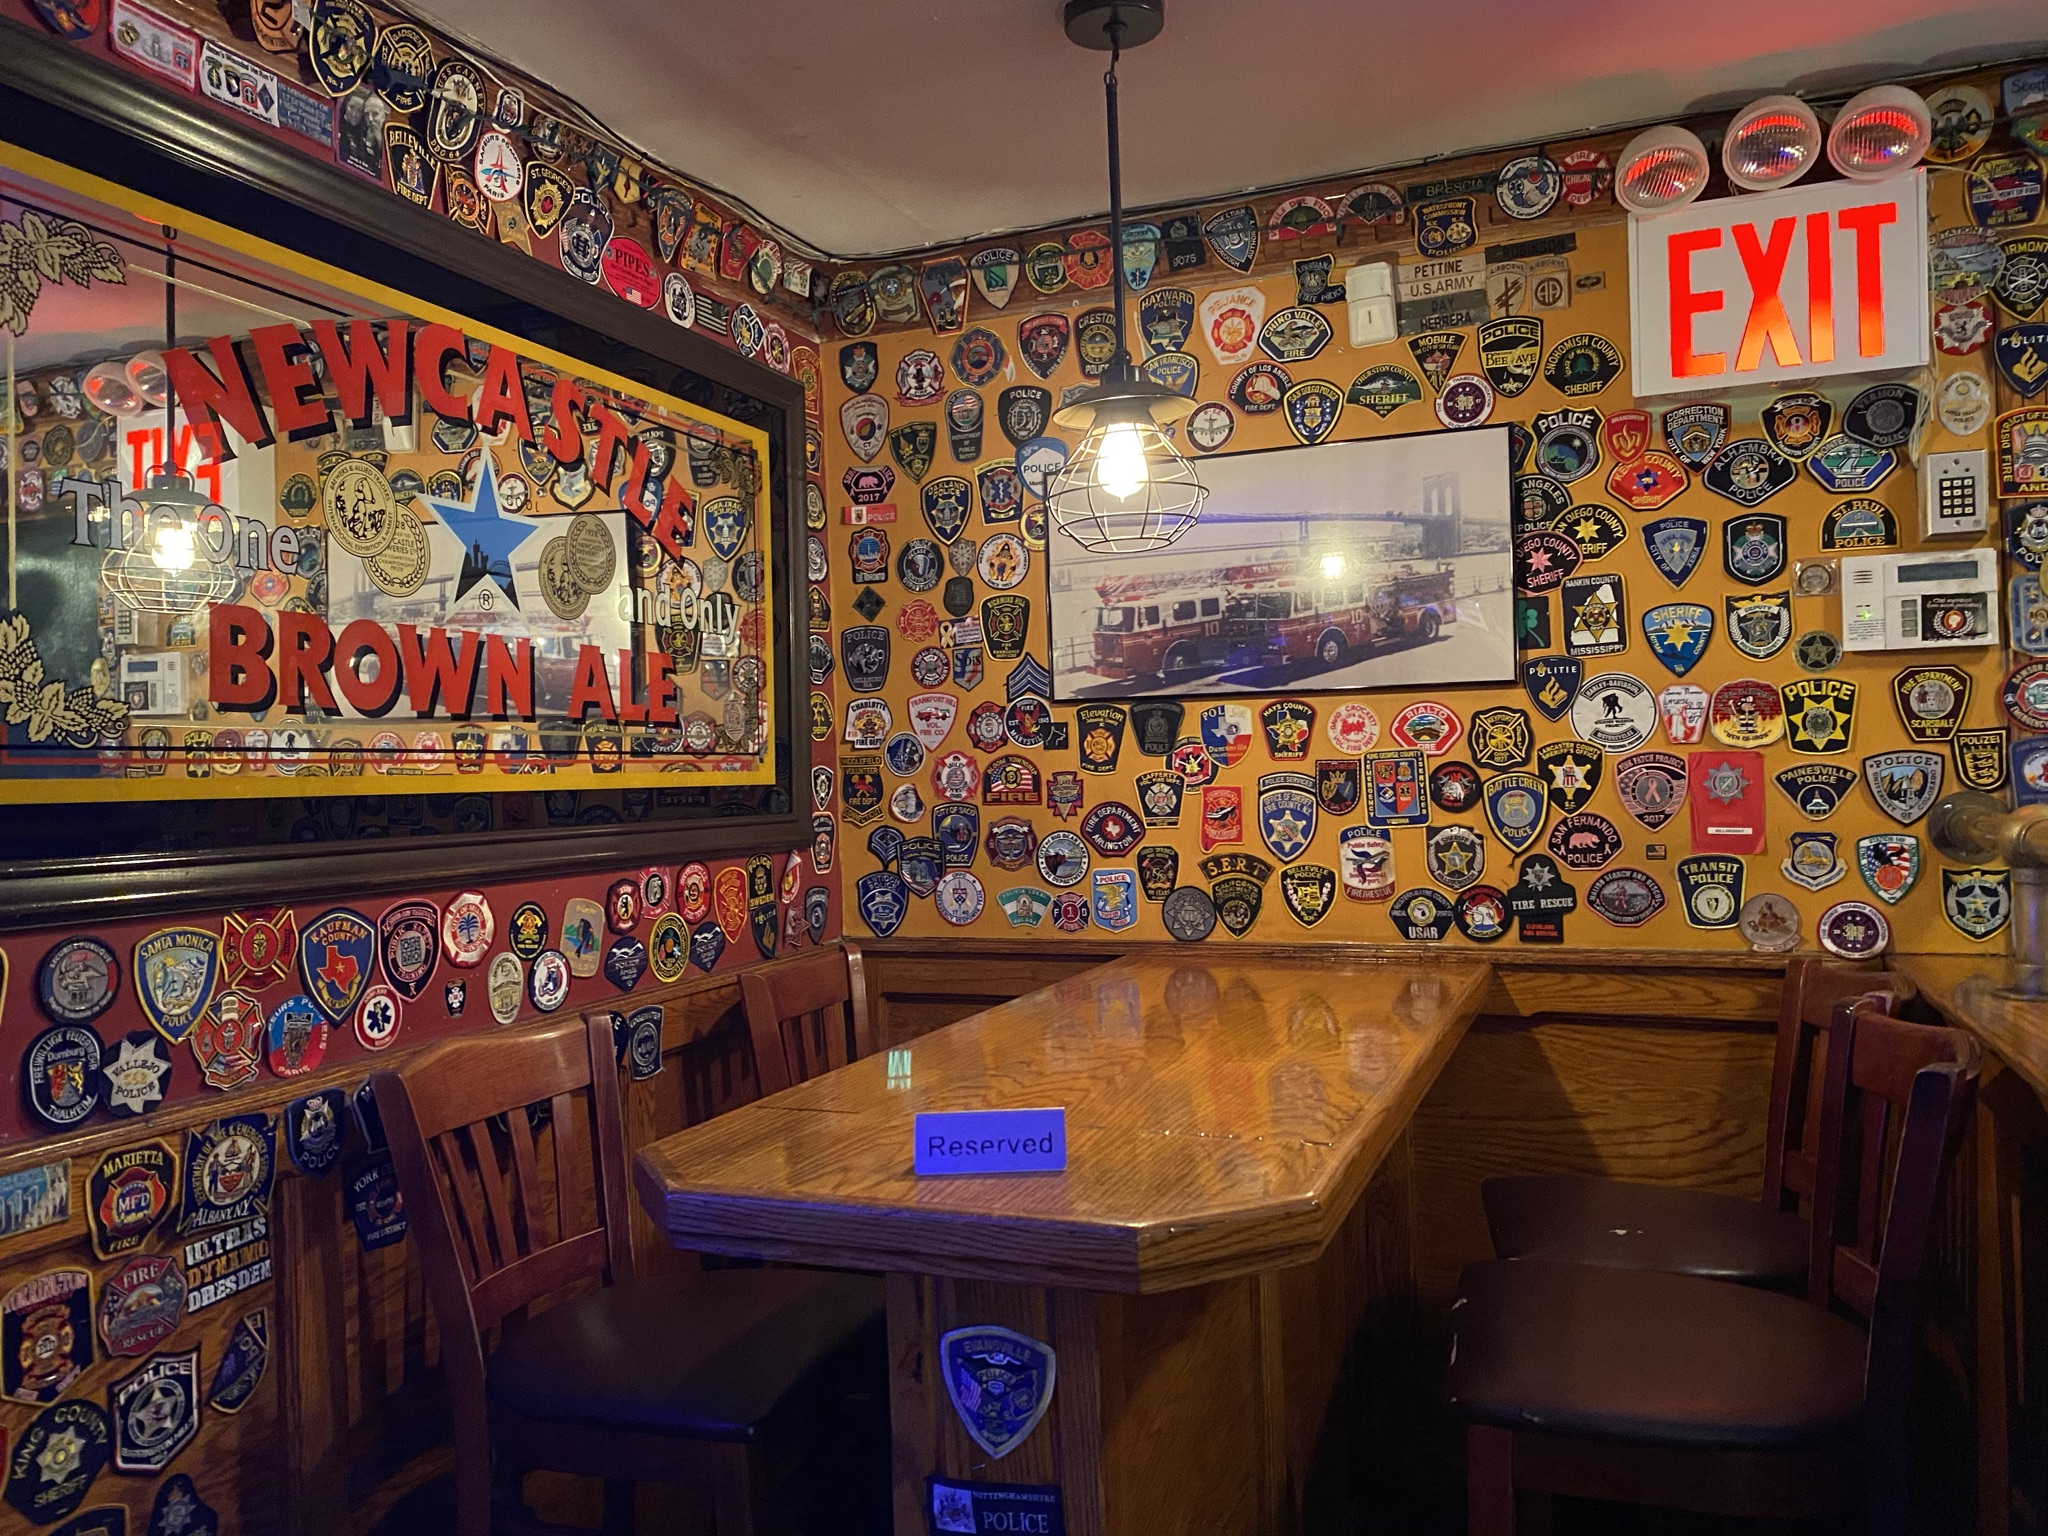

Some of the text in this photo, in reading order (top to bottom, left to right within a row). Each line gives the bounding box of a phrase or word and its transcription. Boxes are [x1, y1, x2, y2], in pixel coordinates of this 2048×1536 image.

[437, 65, 485, 111] USS CARNEY
[388, 129, 437, 168] BELLEVILLE
[1569, 152, 1593, 164] FIRE
[483, 183, 505, 199] PARIS
[1426, 179, 1484, 197] BRESCIA
[615, 249, 650, 277] PIPES
[976, 252, 1014, 266] POLICE
[1414, 260, 1463, 278] PETTINE
[1668, 202, 1897, 379] EXIT
[1141, 292, 1194, 308] HAYWARD
[1207, 295, 1256, 316] RELIANCE
[1432, 299, 1454, 311] DAY
[1265, 311, 1325, 338] CHINO VALLEY
[1420, 313, 1472, 330] HERRERA
[1418, 335, 1456, 345] MOBILE
[1482, 325, 1539, 343] POLICE
[1284, 349, 1306, 358] FIRE
[1485, 353, 1507, 367] BEE
[1545, 336, 1620, 375] SNOHOMISH COUNTY
[1157, 366, 1182, 375] POLICE
[1355, 365, 1415, 386] THURSTON COUNTY
[1009, 389, 1042, 400] POLICE
[1564, 381, 1604, 395] SHERIFF
[1359, 393, 1410, 405] SHERIFF
[1666, 404, 1724, 422] CORRECTION
[1538, 412, 1595, 433] POLICE
[1667, 415, 1725, 432] DEPARTMENT
[162, 318, 697, 558] NEWCASTLE
[1714, 442, 1785, 471] ALHAMBRA
[1023, 462, 1061, 474] POLICE
[1644, 456, 1684, 479] COUNTY
[2002, 455, 2013, 482] FIRE
[330, 466, 348, 491] BREWERS
[355, 466, 372, 478] ALLIED
[373, 473, 390, 501] TRADERS
[928, 481, 965, 496] OAKLAND
[1728, 481, 1774, 500] POLICE
[1835, 478, 1867, 488] POLICE
[857, 493, 880, 502] 2017
[933, 490, 961, 499] POLICE
[1522, 481, 1565, 505] ANGELES
[59, 478, 174, 553] The
[867, 512, 896, 522] POLICE
[1832, 501, 1885, 520] ST. PAUL
[328, 500, 354, 550] INTERNATIONAL
[355, 542, 382, 550] EXHIBITION
[1566, 507, 1624, 539] DIEGO COUNTY
[1660, 521, 1689, 529] POLICE
[1835, 537, 1885, 548] POLICE
[1526, 569, 1564, 588] SHERIFF
[1565, 575, 1619, 588] RANKIN COUNTY
[620, 581, 741, 645] and Only
[1651, 606, 1704, 623] SHERIFF
[1204, 621, 1219, 636] 10
[846, 631, 885, 643] POLICE
[1570, 644, 1625, 656] MISSISSIPPI
[208, 602, 678, 722] BROWN ALE
[1585, 680, 1640, 696] HARLEY-DAVIDSON
[1783, 682, 1854, 701] POLICE
[850, 702, 887, 713] CHARLOTTE
[1080, 709, 1124, 722] Elevation
[1202, 706, 1247, 721] POLICE
[1263, 703, 1312, 717] HAYS COUNTY
[1406, 707, 1447, 719] RIALTO
[1331, 705, 1377, 730] DAVID CROCKETT
[1960, 736, 2000, 745] POLIZEI
[1538, 743, 1575, 755] LANCASTER
[1576, 743, 1601, 755] COUNTY
[841, 757, 881, 765] MIDDLEFIELD
[1874, 756, 1933, 768] POLICE
[1141, 772, 1179, 782] LAFFERTY
[1265, 777, 1313, 787] POLICE SERVICES
[1780, 765, 1855, 784] PAINESVILLE
[1797, 773, 1837, 785] POLICE
[1488, 778, 1544, 797] BATTLE CREEK
[1873, 772, 1897, 812] UNIVERSITY
[1918, 770, 1936, 810] COLORADO
[986, 792, 1038, 802] FIRE
[1086, 815, 1099, 833] FIRE
[1099, 807, 1142, 834] DEPARTMENT
[1643, 814, 1665, 823] 2017
[1347, 828, 1382, 838] POLICE
[1503, 826, 1533, 838] POLICE
[1551, 816, 1617, 845] SAN FERNANDO
[901, 843, 941, 851] POLICE
[1091, 834, 1134, 850] ARLINGTON
[748, 858, 772, 873] POLICE
[946, 854, 969, 862] POLICE
[1567, 854, 1604, 864] POLICE
[1681, 863, 1741, 874] TRANSIT
[1099, 875, 1127, 883] POLICE
[1689, 873, 1734, 884] POLICE
[869, 883, 898, 891] POLICE
[1002, 890, 1048, 899] POLICIA LOCAL
[1589, 870, 1664, 904] MALIBU SEARCH AND RESCUE
[1512, 897, 1574, 910] FIRE RESCUE
[309, 920, 368, 944] KAUFMAN
[321, 932, 359, 945] COUNTY
[1409, 927, 1438, 939] USAR
[140, 935, 214, 959] SANTA MONICA
[390, 923, 433, 959] PUBLIC SAFETY
[161, 1014, 194, 1026] POLICE
[112, 1059, 160, 1077] VALLEJO
[278, 1064, 311, 1076] PARIS
[114, 1083, 156, 1100] POLICE
[48, 1096, 93, 1121] THALHEIM
[928, 1132, 1053, 1157] Reserved
[102, 1150, 164, 1178] MARIETTA
[119, 1194, 150, 1212] MFD
[109, 1235, 141, 1252] FIRE
[185, 1217, 266, 1266] ULTRAS
[123, 1262, 160, 1289] FIRE
[187, 1260, 272, 1313] DRESDEN
[119, 1361, 193, 1405] POLICE
[13, 1405, 108, 1480] KING COUNTY
[34, 1473, 89, 1508] SHERIFF
[972, 1490, 1056, 1503] NOTTINGHAMSHIRE
[983, 1511, 1049, 1533] POLICE
